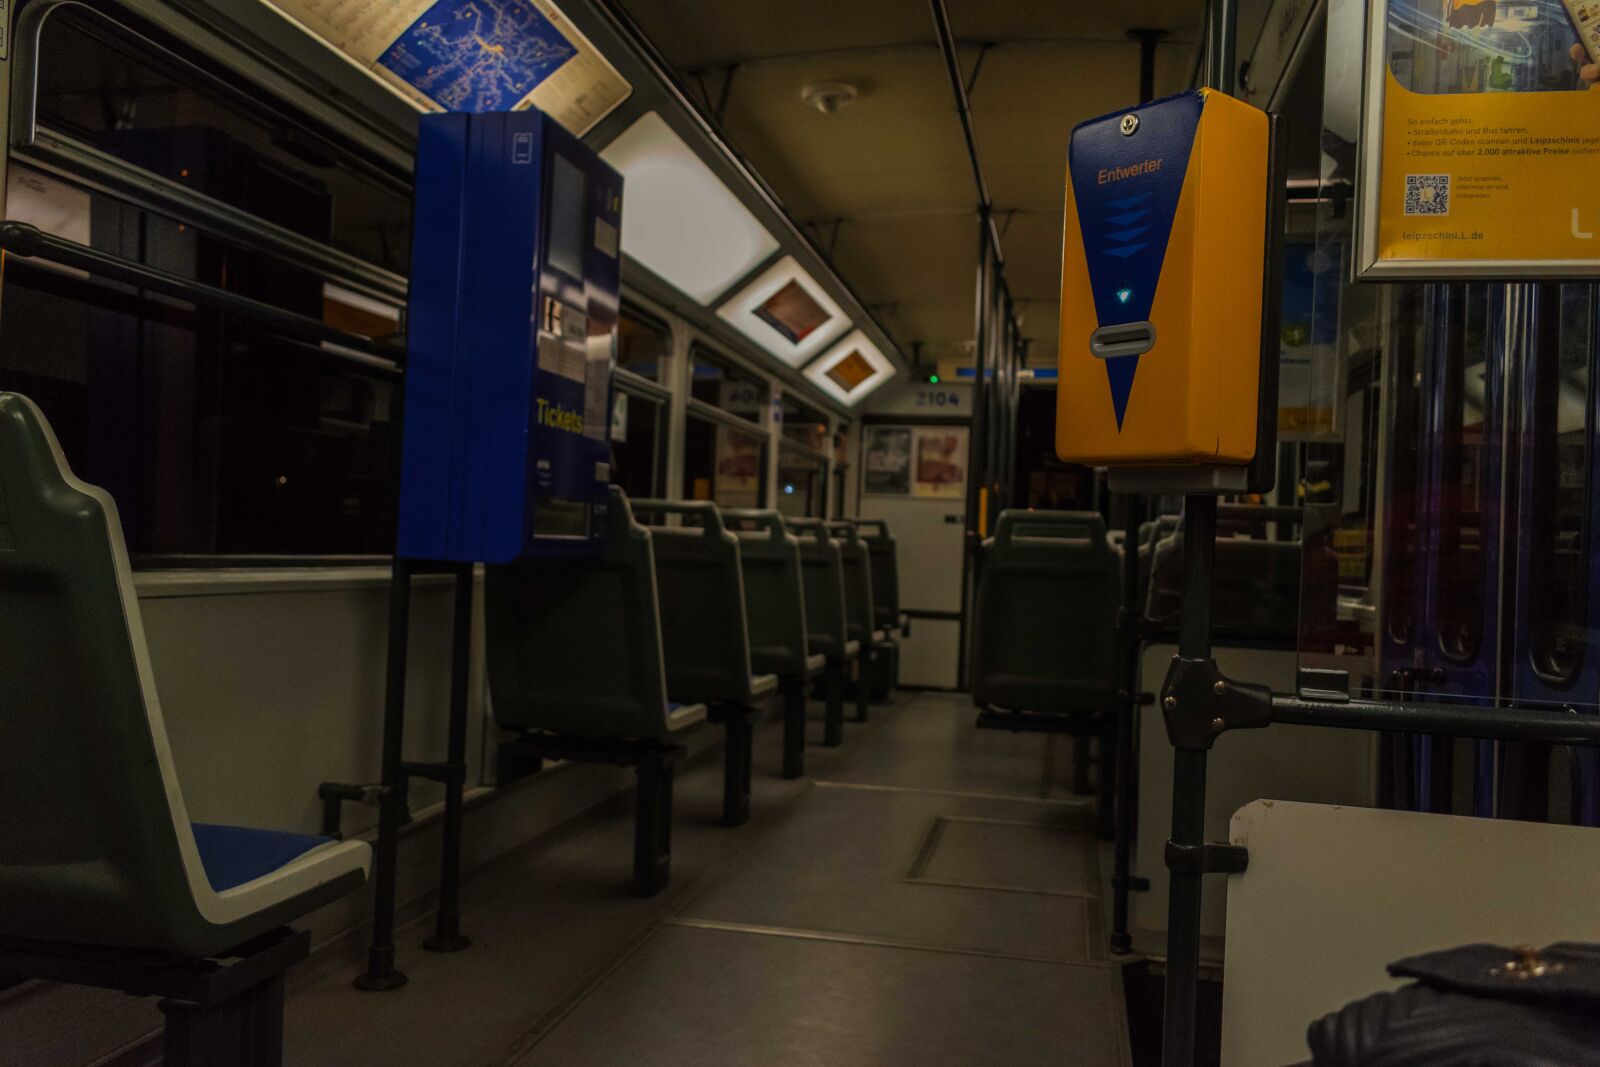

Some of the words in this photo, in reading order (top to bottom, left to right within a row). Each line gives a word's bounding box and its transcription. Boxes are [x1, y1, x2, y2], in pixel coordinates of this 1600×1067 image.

[1465, 127, 1481, 135] und
[1482, 126, 1499, 135] Bus
[1512, 136, 1528, 145] und
[1410, 149, 1441, 158] Chance
[1501, 147, 1542, 157] attraktive
[1543, 147, 1570, 155] Preise
[1098, 159, 1163, 184] Entwerter
[915, 391, 960, 407] 2104
[536, 397, 584, 434] Tickets
